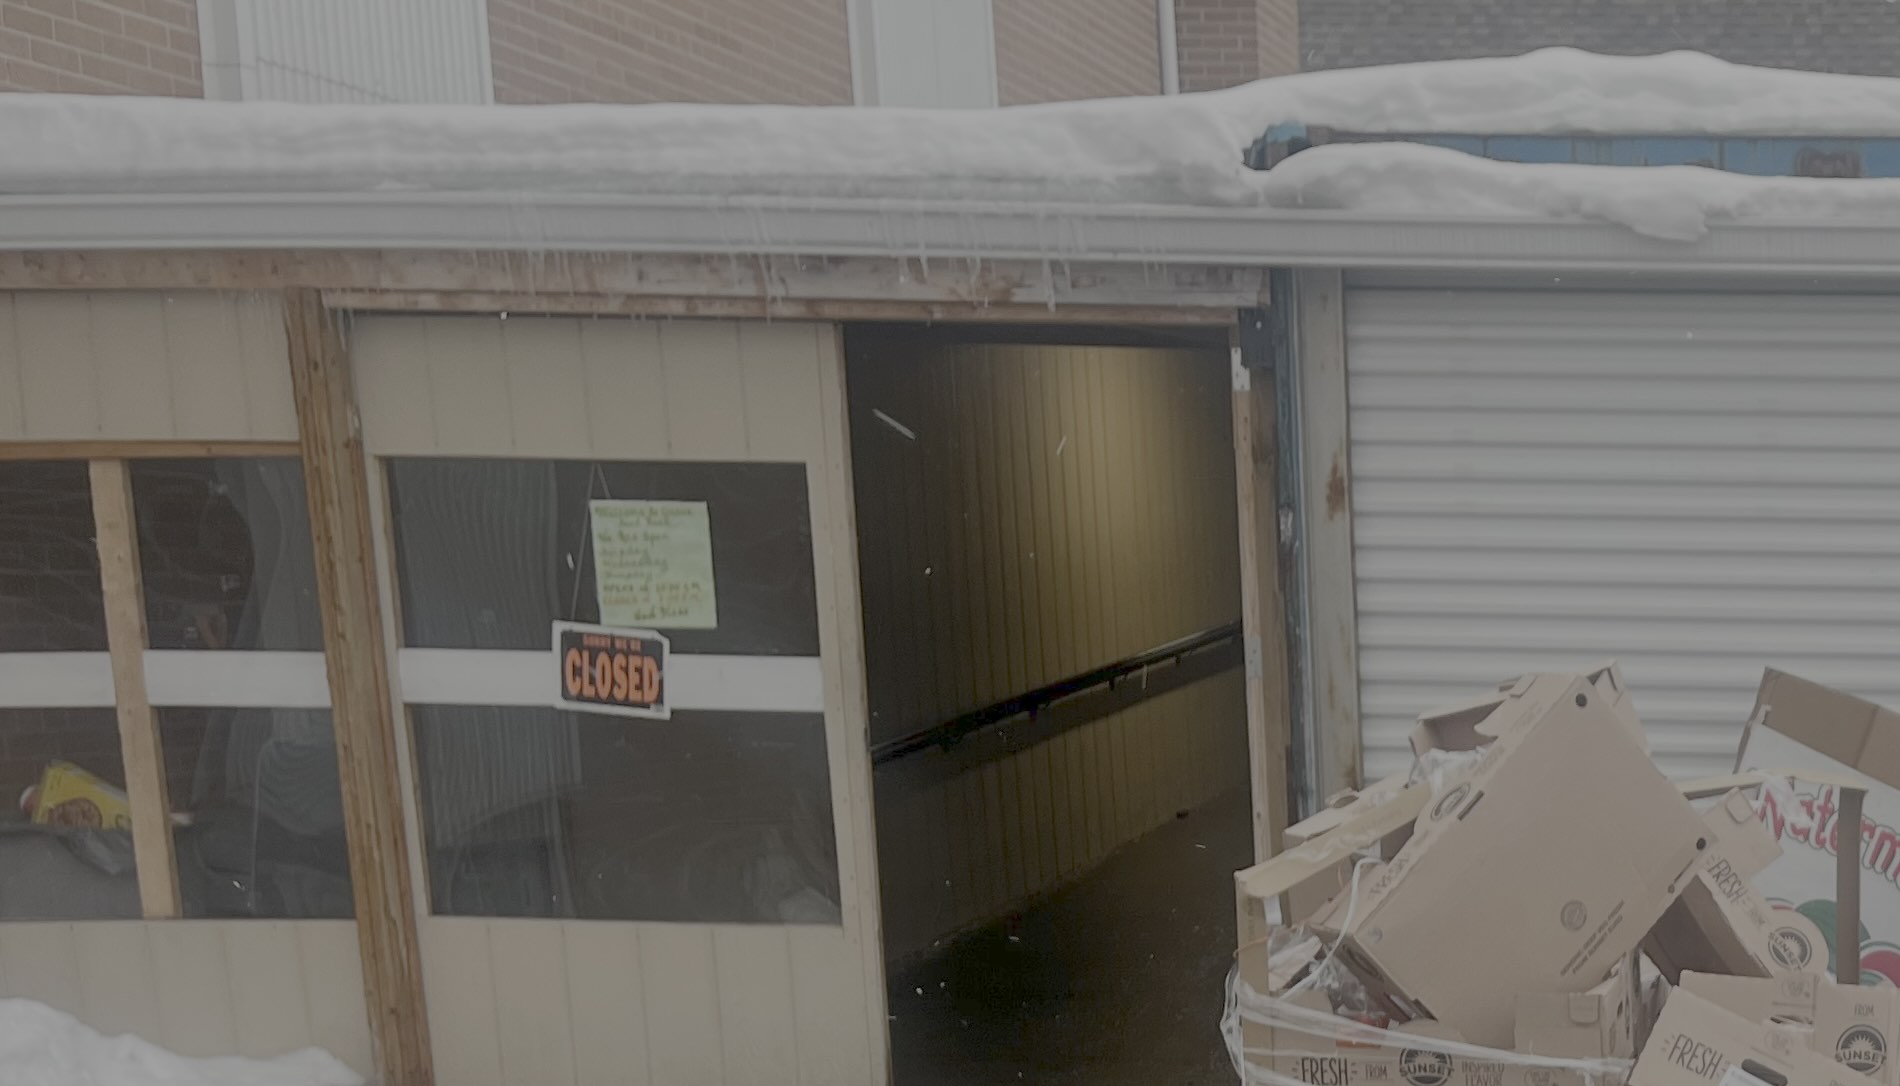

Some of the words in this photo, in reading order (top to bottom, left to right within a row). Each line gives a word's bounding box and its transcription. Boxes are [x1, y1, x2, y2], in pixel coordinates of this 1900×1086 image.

[565, 647, 660, 705] CLOSED
[1706, 859, 1749, 905] FRESH
[1767, 931, 1802, 972] SUNSET
[1854, 1004, 1875, 1017] FROM
[1300, 1057, 1349, 1086] FRESH
[1365, 1065, 1387, 1080] FROM
[1399, 1063, 1454, 1079] SUNSET
[1667, 1034, 1723, 1081] FRESH
[1835, 1051, 1887, 1065] SUNSET
